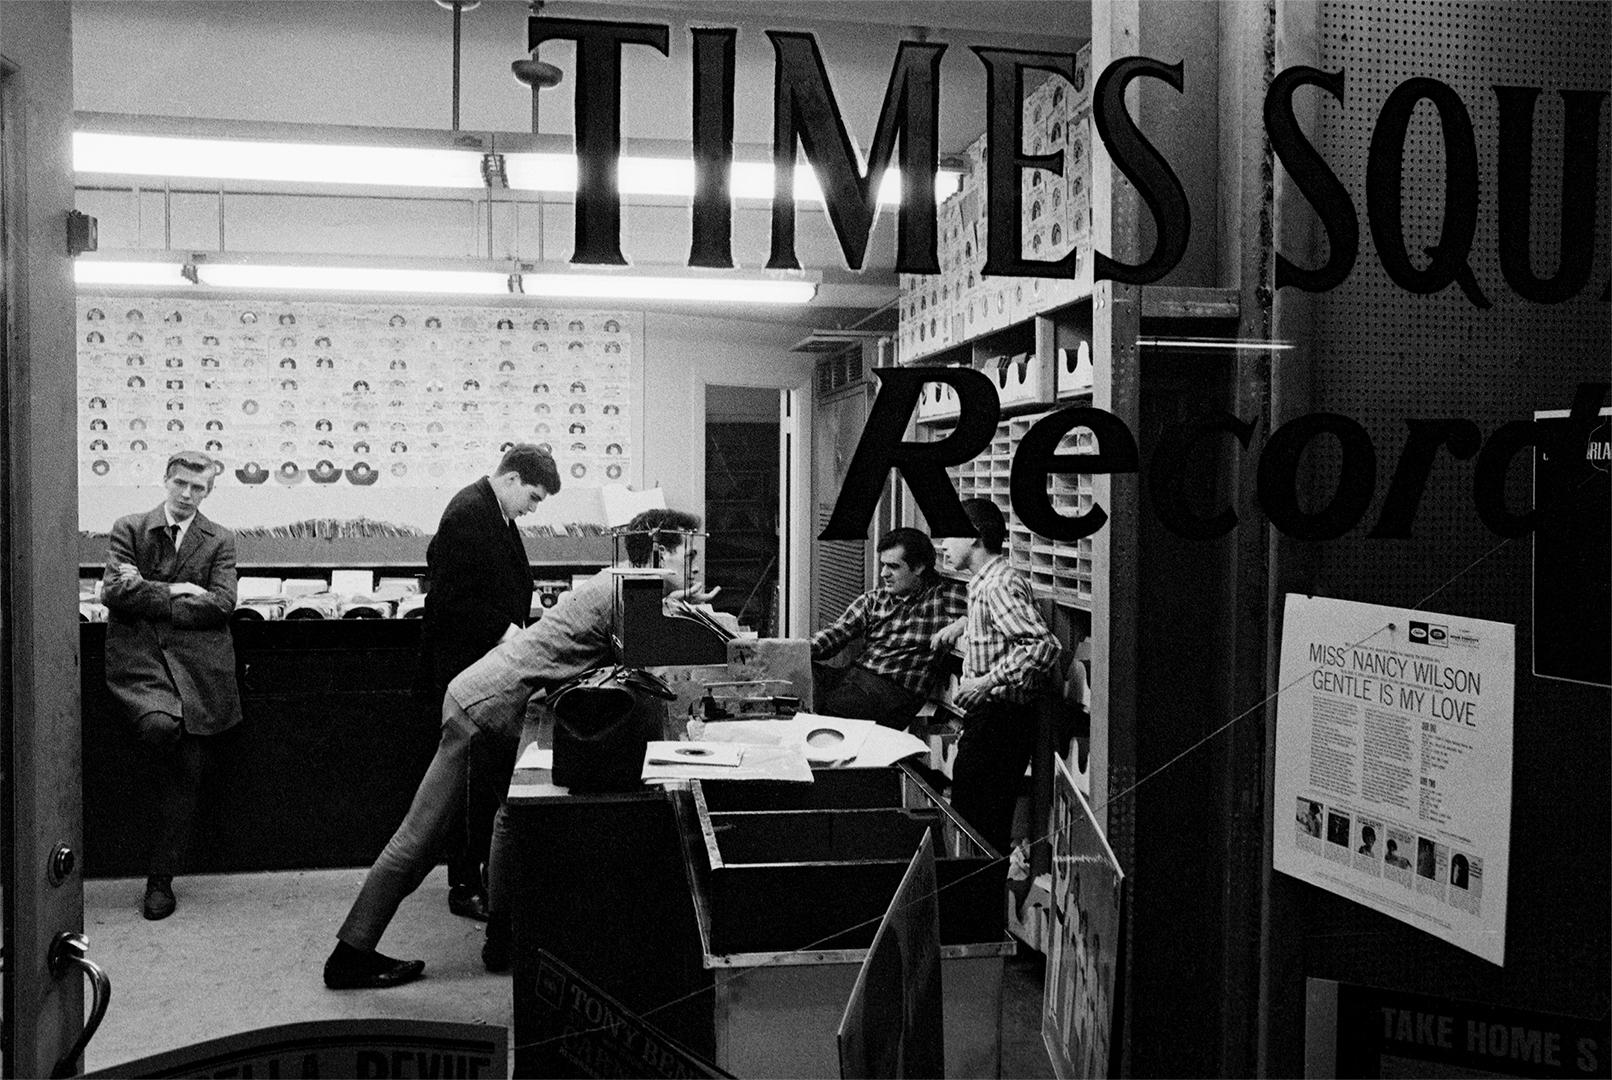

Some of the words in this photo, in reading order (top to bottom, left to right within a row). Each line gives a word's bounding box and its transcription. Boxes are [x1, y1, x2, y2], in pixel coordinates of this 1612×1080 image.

[528, 16, 1191, 285] TIMES
[1264, 65, 1612, 309] SQU
[1309, 642, 1346, 668] MISS
[1353, 650, 1408, 680] NANCY
[1413, 661, 1481, 696] WILSON
[1312, 669, 1372, 702] GENTLE
[1379, 683, 1394, 706] IS
[1400, 687, 1425, 713] MY
[1431, 694, 1477, 727] LOVE
[569, 984, 640, 1050] TONY
[1381, 1006, 1454, 1049] TAKE
[1466, 1019, 1561, 1067] HOME
